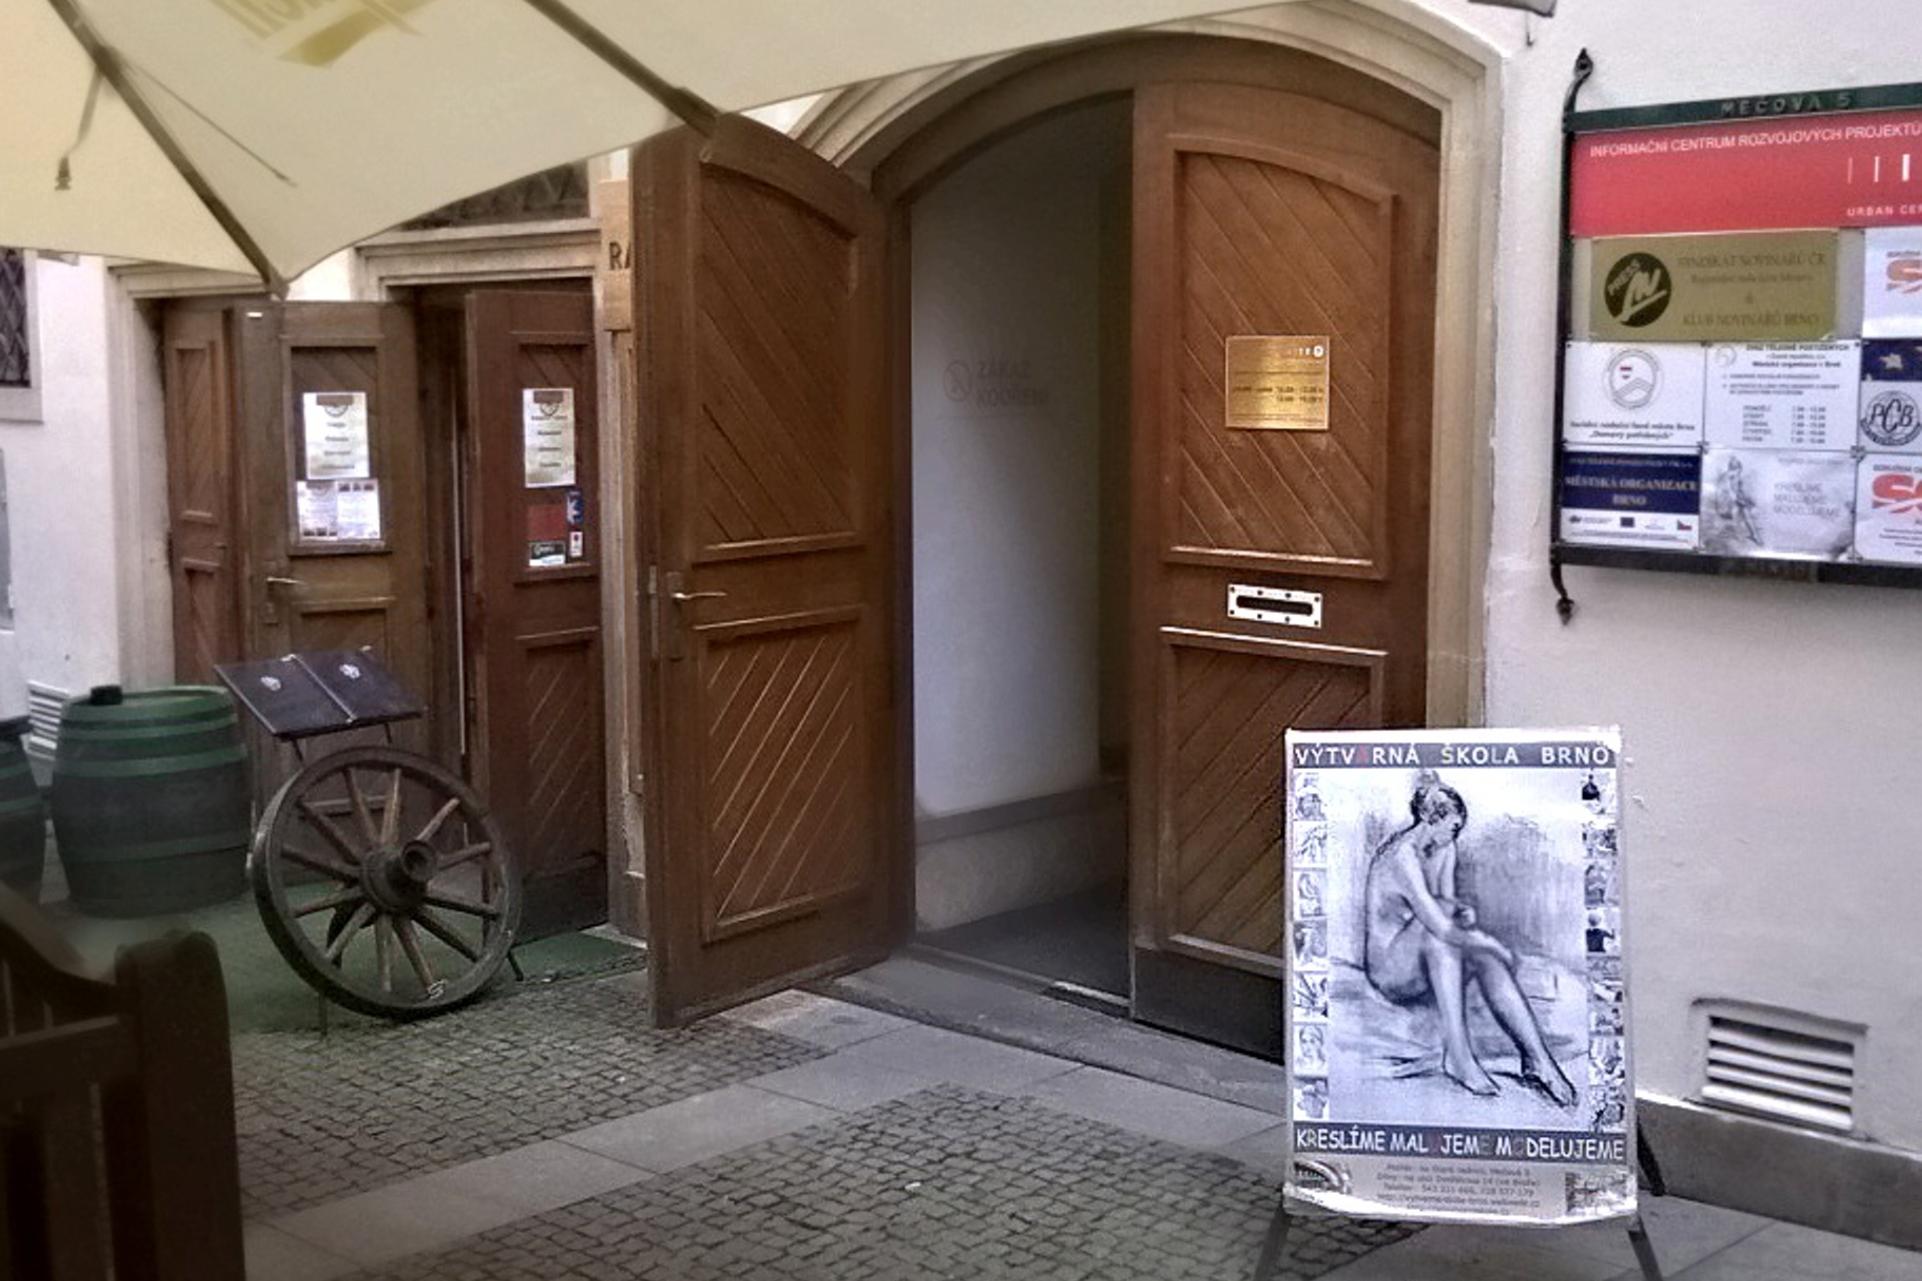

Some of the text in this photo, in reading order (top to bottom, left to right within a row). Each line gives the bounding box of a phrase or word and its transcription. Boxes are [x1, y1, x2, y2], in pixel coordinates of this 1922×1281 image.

[1838, 91, 1852, 107] 5
[1590, 140, 1668, 157] INFORMAČNÍ
[1671, 136, 1736, 151] CENTRUM
[1738, 127, 1842, 146] ROZVOJOVÝCH
[1847, 205, 1894, 216] URBAN
[1441, 742, 1519, 764] ŠKOLA
[1541, 746, 1609, 765] BRNO
[1297, 1124, 1386, 1152] KRESLÍME
[1390, 1132, 1491, 1155] MALJEME
